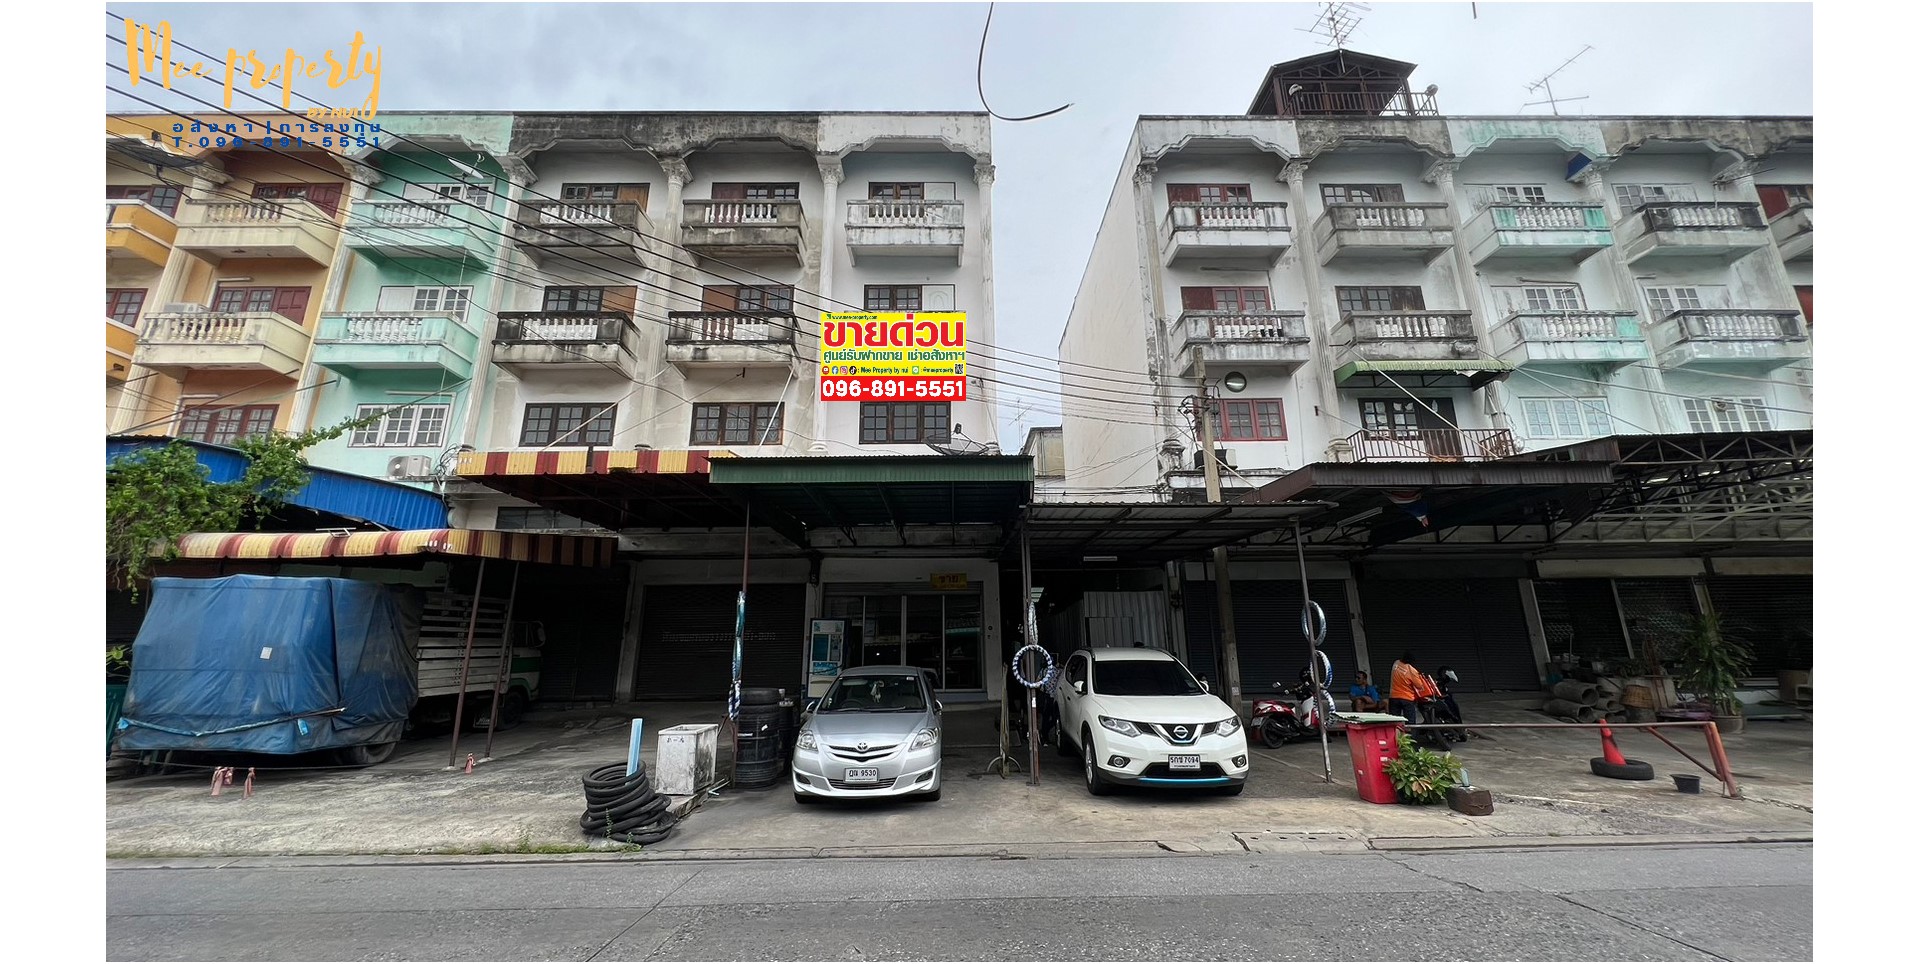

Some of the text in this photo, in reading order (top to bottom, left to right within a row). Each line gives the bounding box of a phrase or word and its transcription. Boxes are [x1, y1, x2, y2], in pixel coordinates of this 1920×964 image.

[823, 313, 964, 347] ขายด่วน
[823, 348, 965, 363] ศูนย์รับฝากขาย เช่าอสังหาฯ
[822, 379, 963, 397] 096-891-5551
